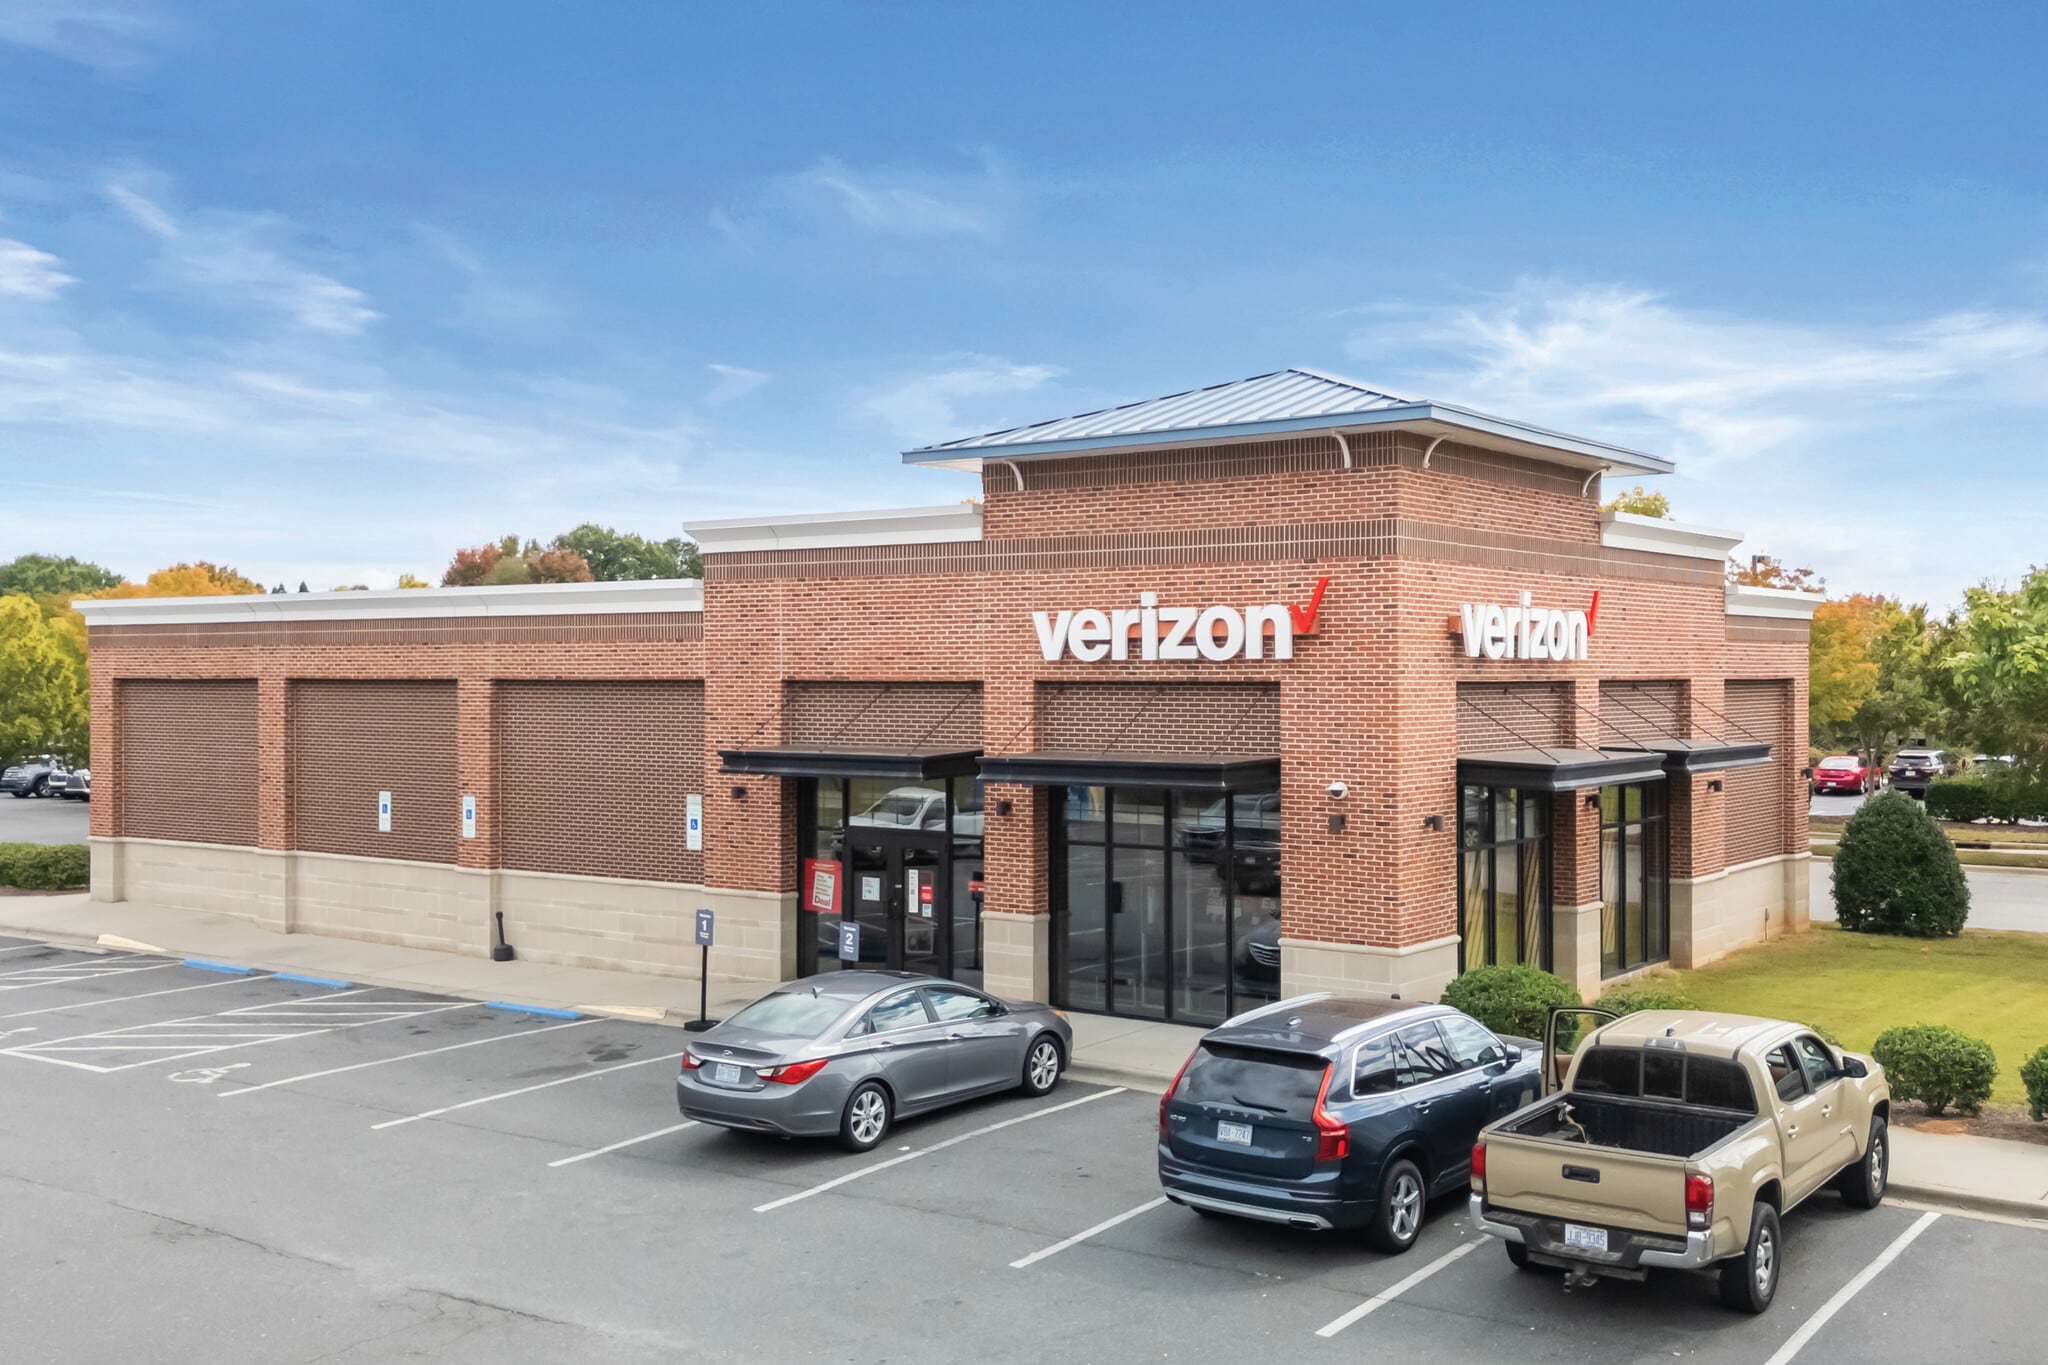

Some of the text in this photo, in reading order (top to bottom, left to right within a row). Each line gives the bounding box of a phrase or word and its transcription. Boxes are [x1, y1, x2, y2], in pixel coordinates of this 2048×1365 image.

[1032, 591, 1294, 662] verizon
[1460, 590, 1588, 661] verizon
[702, 919, 707, 931] 1
[845, 932, 854, 945] 2
[1202, 1105, 1265, 1121] VOLVO
